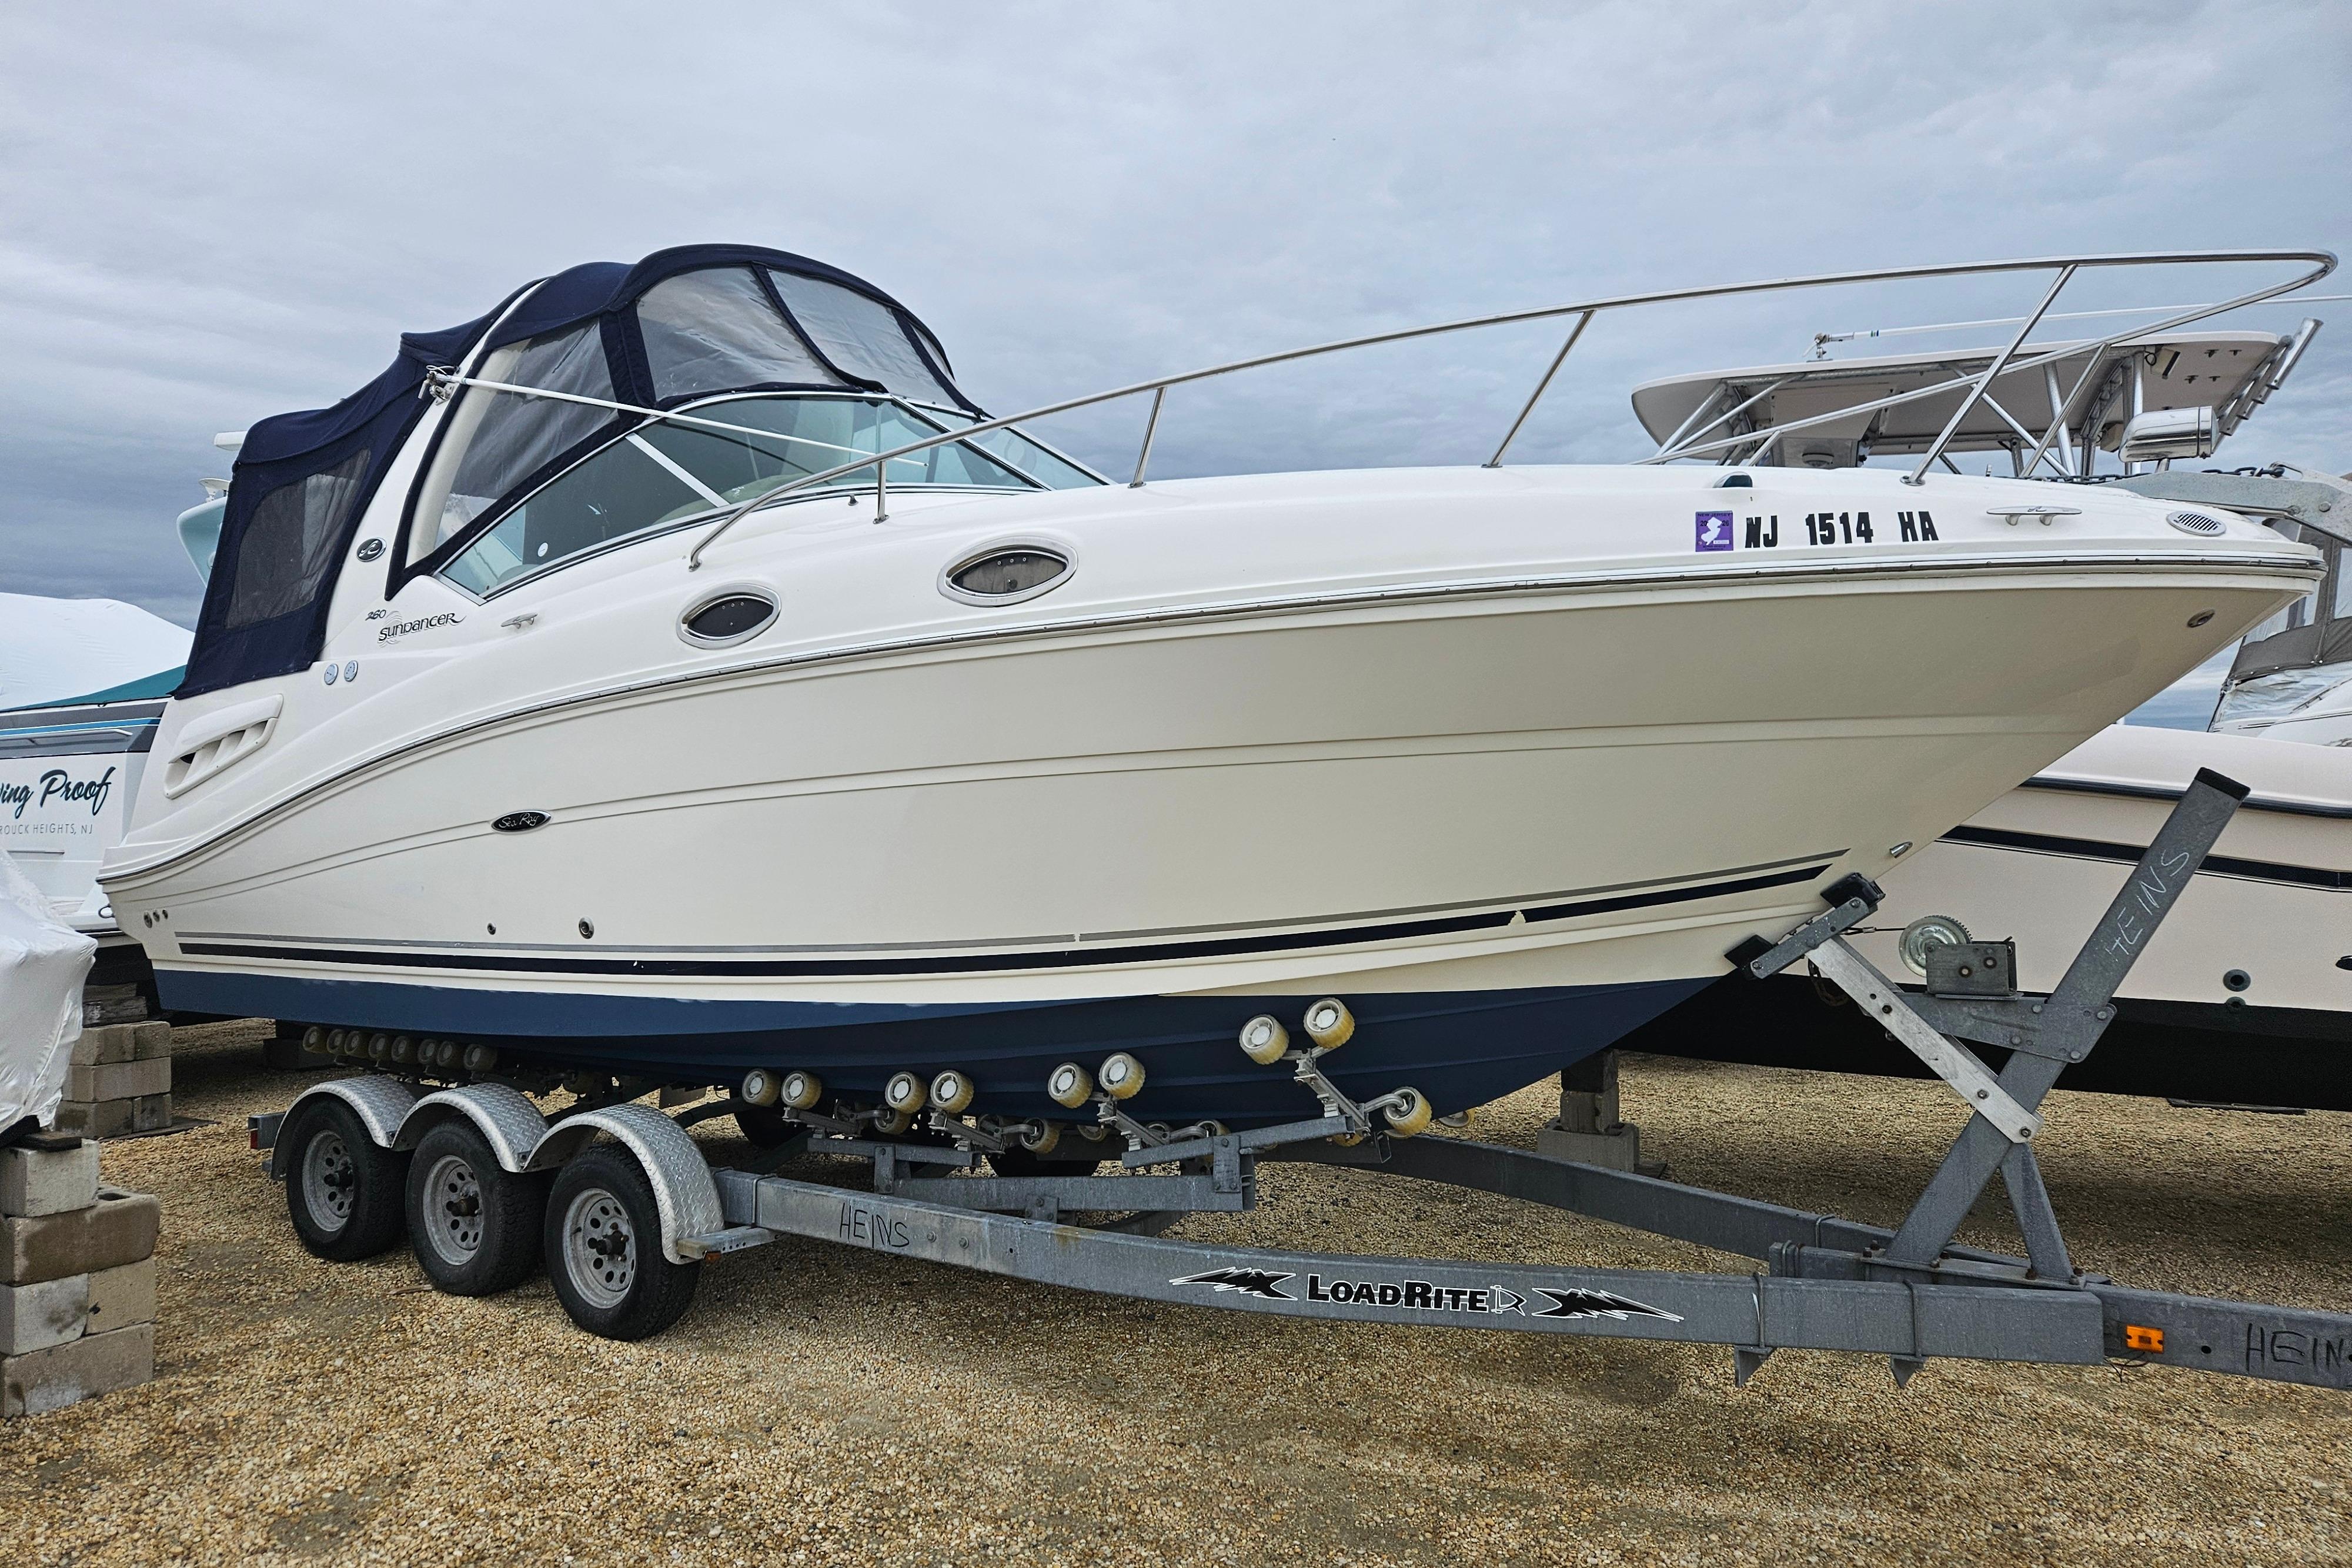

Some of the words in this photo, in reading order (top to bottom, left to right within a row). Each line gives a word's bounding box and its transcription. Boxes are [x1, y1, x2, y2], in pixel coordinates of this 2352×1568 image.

[1745, 515, 1778, 549] NJ
[1805, 511, 1874, 546] 1514
[1897, 511, 1939, 542] HA
[365, 609, 386, 621] 260
[39, 766, 116, 816] Proof
[33, 823, 76, 835] HEIGHTS,
[81, 824, 92, 834] NJ
[498, 817, 517, 828] Sea
[519, 813, 540, 826] Ray
[840, 1202, 910, 1249] HEINS
[2246, 1323, 2352, 1373] HEIN
